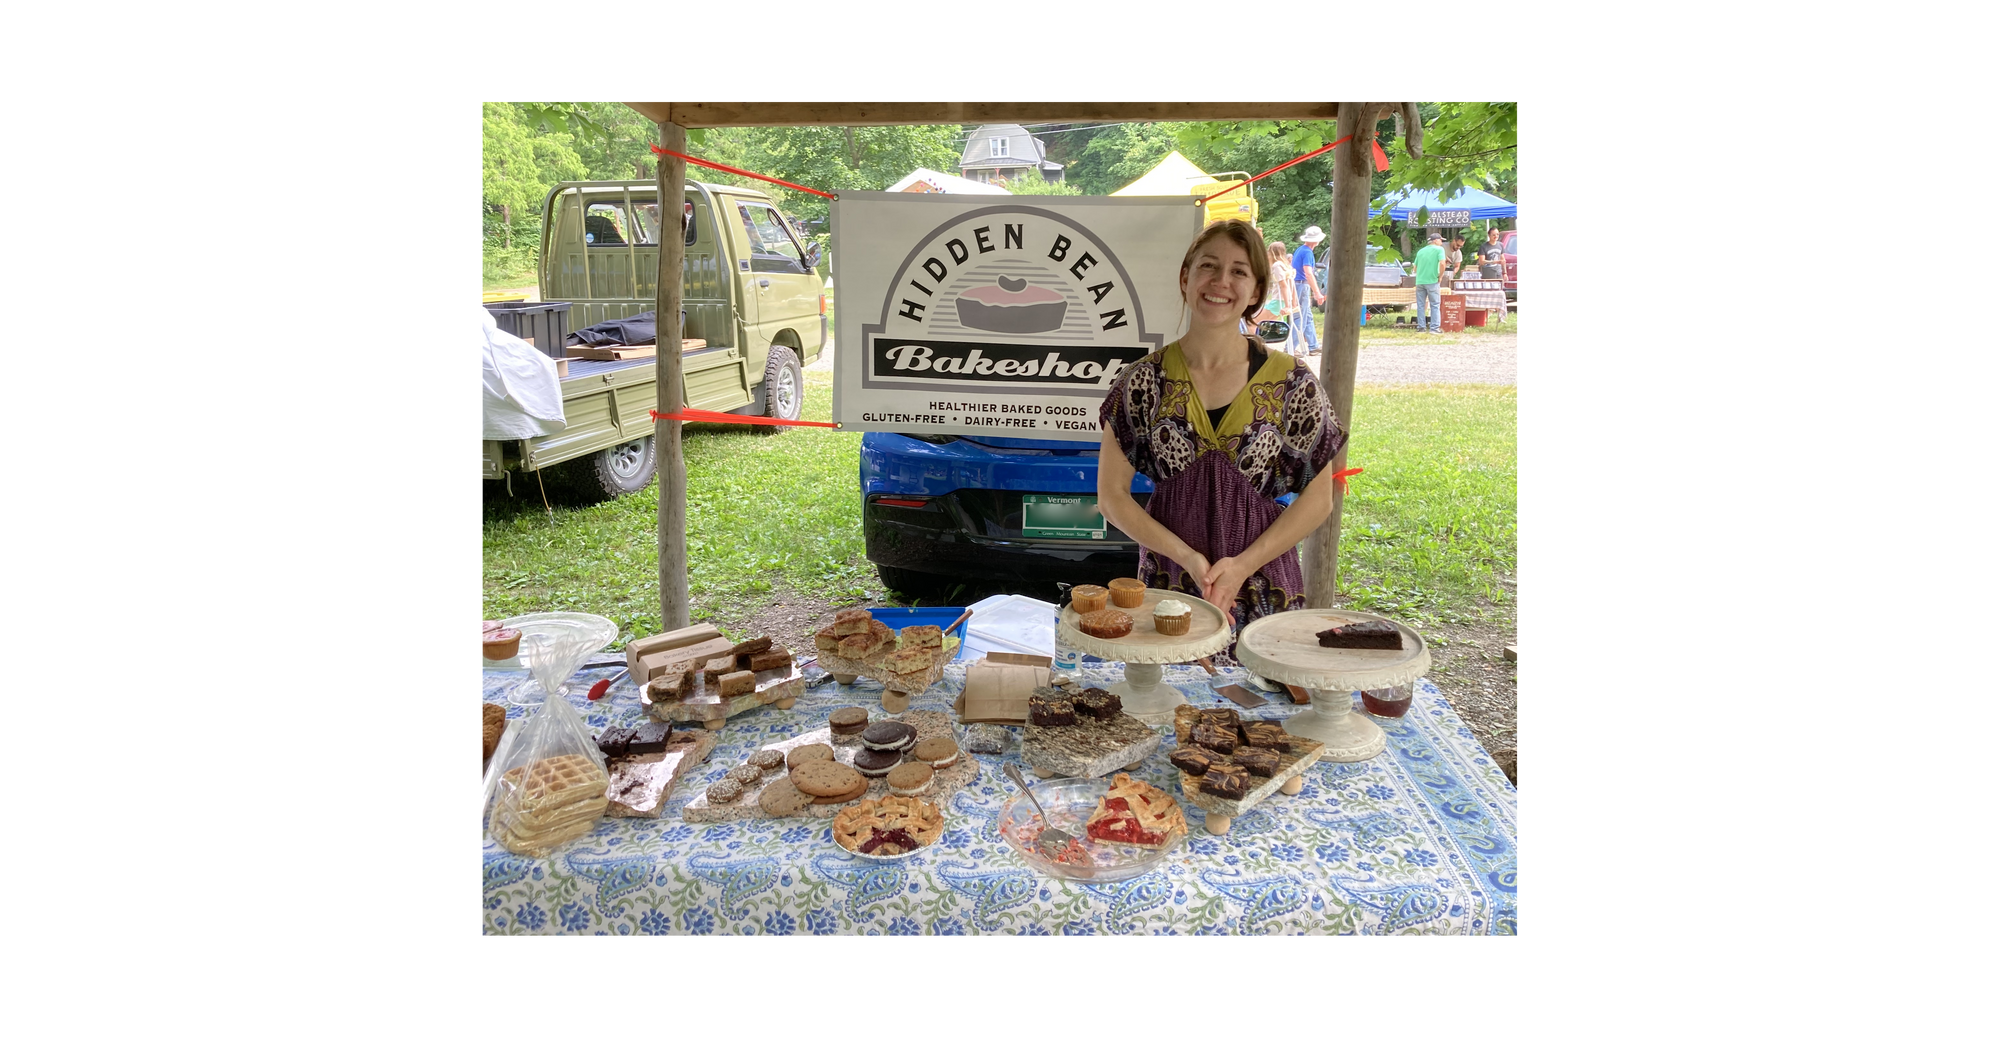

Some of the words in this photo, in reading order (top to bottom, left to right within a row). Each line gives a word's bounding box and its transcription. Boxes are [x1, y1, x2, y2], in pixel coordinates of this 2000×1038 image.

[898, 223, 1024, 323] HIDDEN
[1047, 233, 1128, 331] BEAN
[885, 345, 1130, 388] Bakeshop
[929, 401, 997, 413] HEALTHIER
[1001, 404, 1042, 415] BAKED
[1045, 405, 1087, 416] GOODS
[862, 412, 946, 424] GLUTEN-FREE
[964, 416, 1036, 428] DAIRY-FREE
[1055, 420, 1097, 431] VEGAN
[1047, 496, 1082, 504] Vermont
[663, 651, 690, 659] Bakery
[691, 644, 713, 652] Tissue
